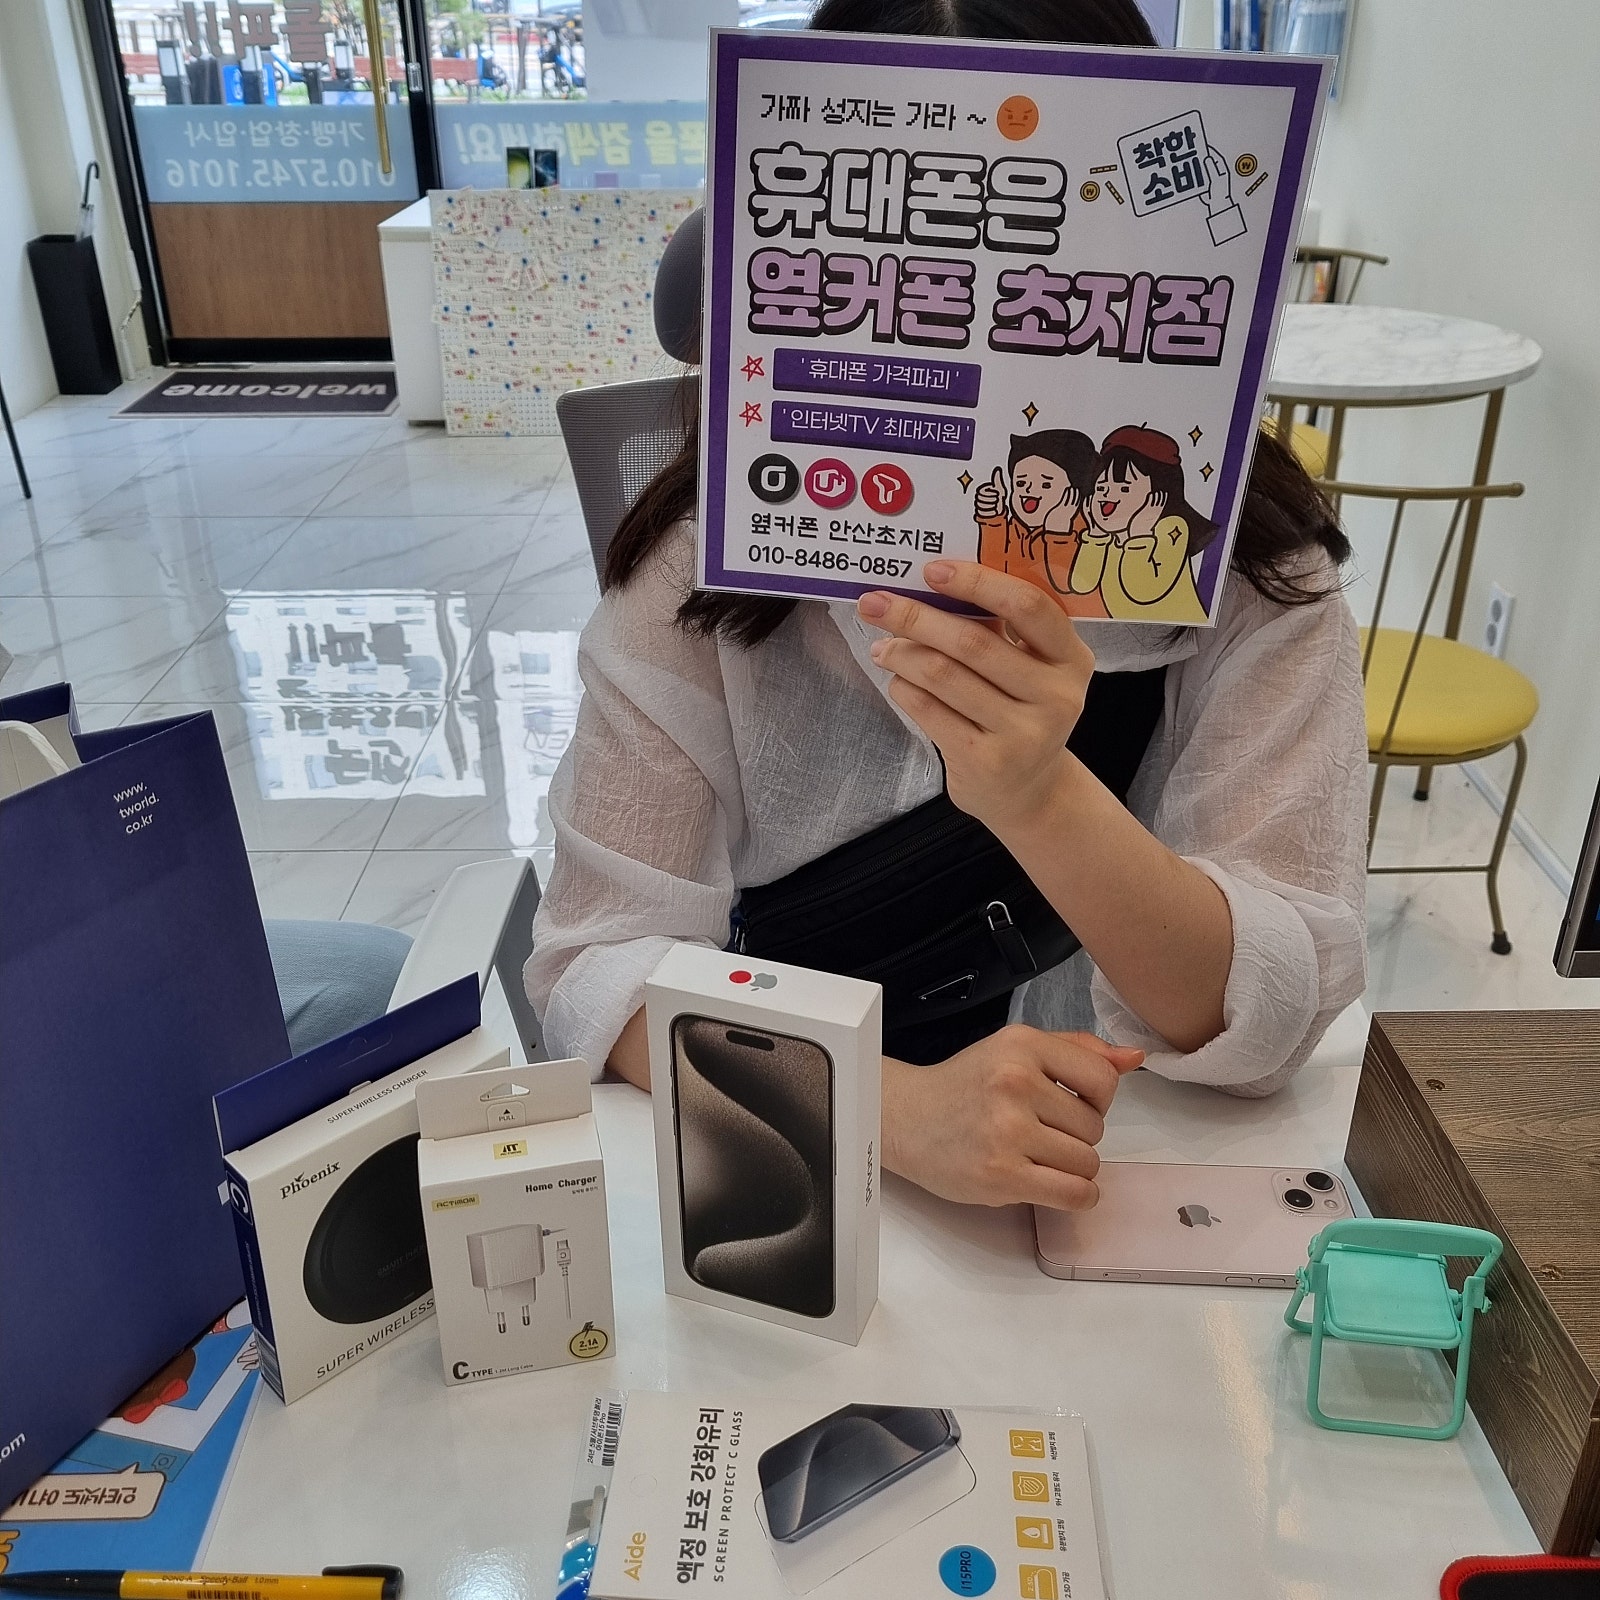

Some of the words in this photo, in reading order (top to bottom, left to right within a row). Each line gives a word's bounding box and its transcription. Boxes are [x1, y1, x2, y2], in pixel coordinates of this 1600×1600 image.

[761, 94, 810, 123] 가짜
[821, 97, 896, 127] 성지는
[906, 102, 956, 131] 가라
[1132, 126, 1198, 170] 착한
[749, 141, 1067, 255] 휴대폰은
[1143, 157, 1205, 206] 소비
[747, 246, 976, 349] 옆커폰
[988, 264, 1235, 366] 초지점
[161, 384, 387, 399] welcome
[751, 512, 819, 539] 옆커폰
[829, 519, 944, 554] 안산초지점
[749, 544, 913, 578] 010-8486-0857
[113, 782, 148, 802] www.
[119, 793, 160, 818] tworld.
[125, 813, 154, 834] co.kr
[327, 1108, 355, 1124] SUPER
[353, 1087, 392, 1111] WIRELESS
[392, 1069, 428, 1091] CHARGER
[280, 1162, 340, 1200] Phoenix
[525, 1182, 553, 1193] Home
[558, 1175, 598, 1188] Charger
[317, 1342, 364, 1379] SUPER
[367, 1298, 435, 1346] WIRELESS
[579, 1338, 598, 1347] 2.1A
[452, 1361, 469, 1380] C
[471, 1367, 494, 1378] TYPE
[690, 1407, 724, 1482] 강화유리
[730, 1410, 743, 1446] GLASS
[729, 1451, 738, 1459] C
[62, 1487, 137, 1505] 인터넷도
[684, 1489, 712, 1531] 보호
[721, 1464, 737, 1521] PROTECT
[624, 1531, 646, 1581] Aide
[676, 1538, 707, 1584] 액정
[714, 1527, 729, 1582] SCREEN
[200, 1575, 249, 1586] Speedy-Ball
[1062, 1571, 1070, 1584] 가공
[1064, 1584, 1072, 1599] 2.5D
